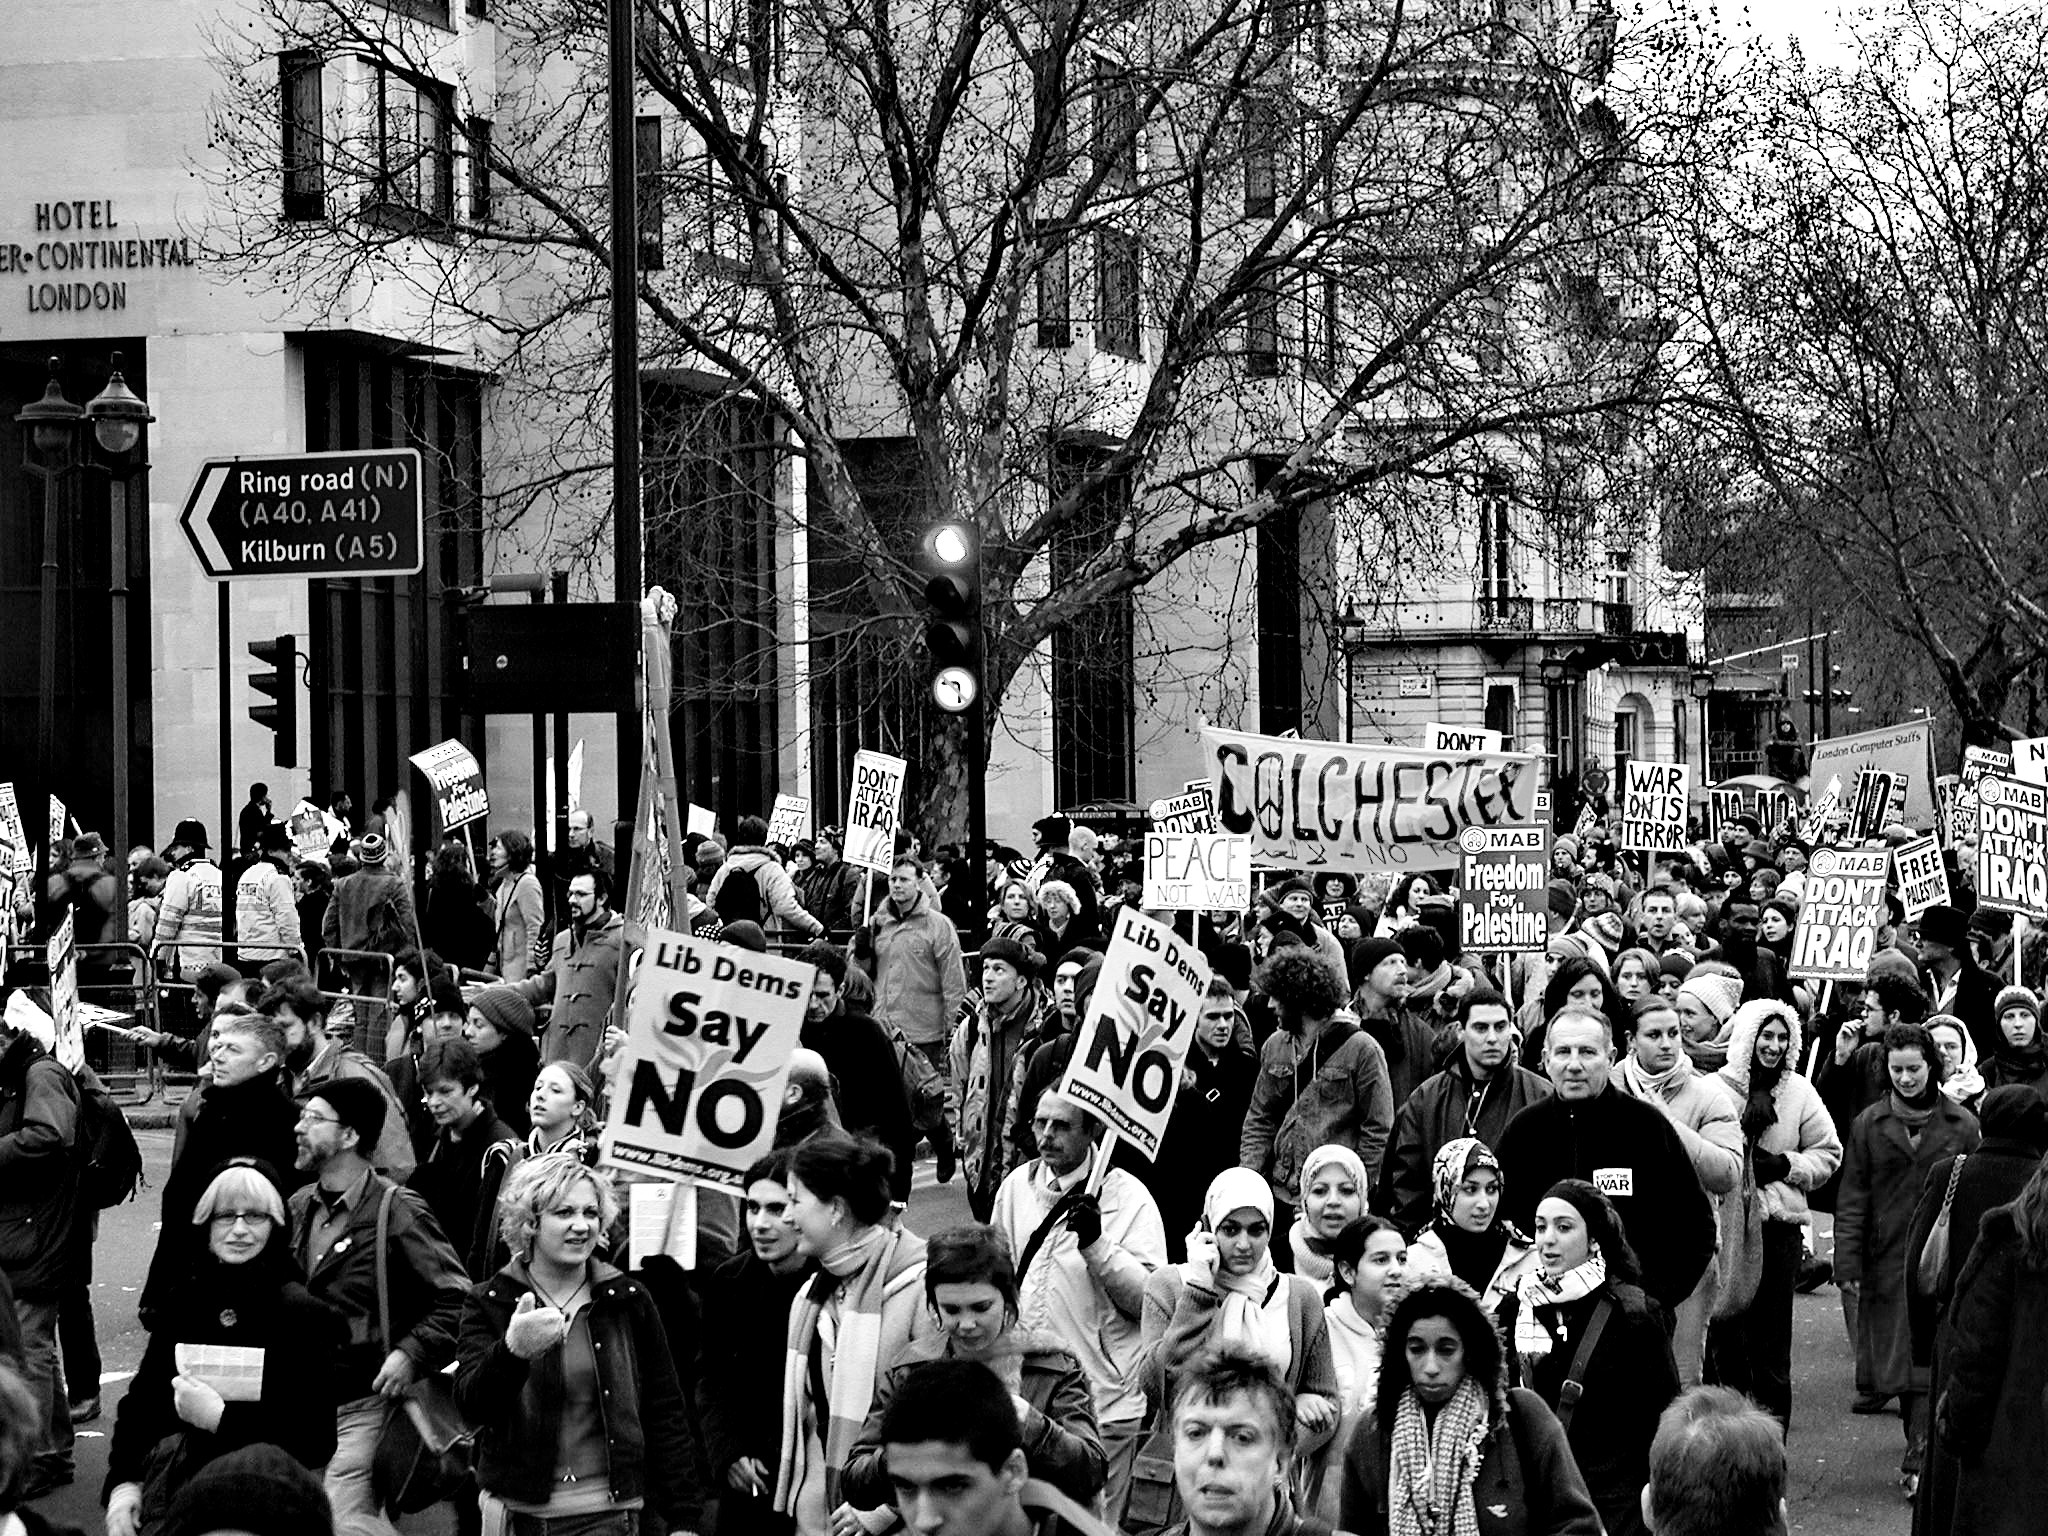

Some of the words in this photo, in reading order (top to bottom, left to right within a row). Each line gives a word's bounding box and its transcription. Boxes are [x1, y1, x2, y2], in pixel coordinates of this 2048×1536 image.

[36, 200, 118, 232] HOTEL
[28, 281, 127, 313] LONDON
[240, 471, 291, 496] Ring
[301, 466, 354, 491] road
[361, 462, 409, 492] (N)
[240, 500, 313, 529] (A40,
[320, 494, 382, 525] A41)
[241, 540, 326, 563] Kilburn
[335, 532, 398, 562] (A5)
[1437, 731, 1486, 750] DON'T
[1816, 746, 1849, 760] London
[1850, 739, 1894, 754] Computer
[1895, 730, 1921, 746] Staffs
[1629, 765, 1683, 795] WAR
[2004, 786, 2041, 808] MAB
[438, 788, 489, 827] Palestine
[853, 800, 893, 839] IRAQ
[1169, 795, 1202, 813] MAB
[1662, 797, 1684, 822] IS
[1153, 810, 1209, 834] DON'T
[1625, 820, 1685, 849] TERROR
[1980, 803, 2047, 843] DON'T
[1491, 833, 1540, 847] MAB
[1980, 832, 2046, 866] ATTACK
[1149, 837, 1244, 882] PEACE
[1465, 854, 1544, 890] Freedom
[1839, 857, 1884, 871] MAB
[1900, 849, 1941, 883] FREE
[1157, 884, 1192, 903] NOT
[1206, 884, 1248, 905] WAR
[1805, 877, 1886, 905] DON'T
[1905, 874, 1946, 908] PALESTINE
[1980, 852, 2048, 912] IRAQ
[1490, 891, 1517, 908] For
[1801, 903, 1880, 926] ATTACK
[1462, 902, 1547, 944] Palestine
[1123, 920, 1161, 952] Lib
[1164, 942, 1205, 997] Dems
[1793, 923, 1874, 972] IRAQ
[657, 943, 702, 974] Lib
[712, 956, 803, 1000] Dems
[1125, 964, 1187, 1042] Say
[663, 991, 771, 1064] Say
[1084, 1013, 1173, 1114] NO
[624, 1058, 764, 1150] NO
[1597, 1180, 1629, 1190] WAR
